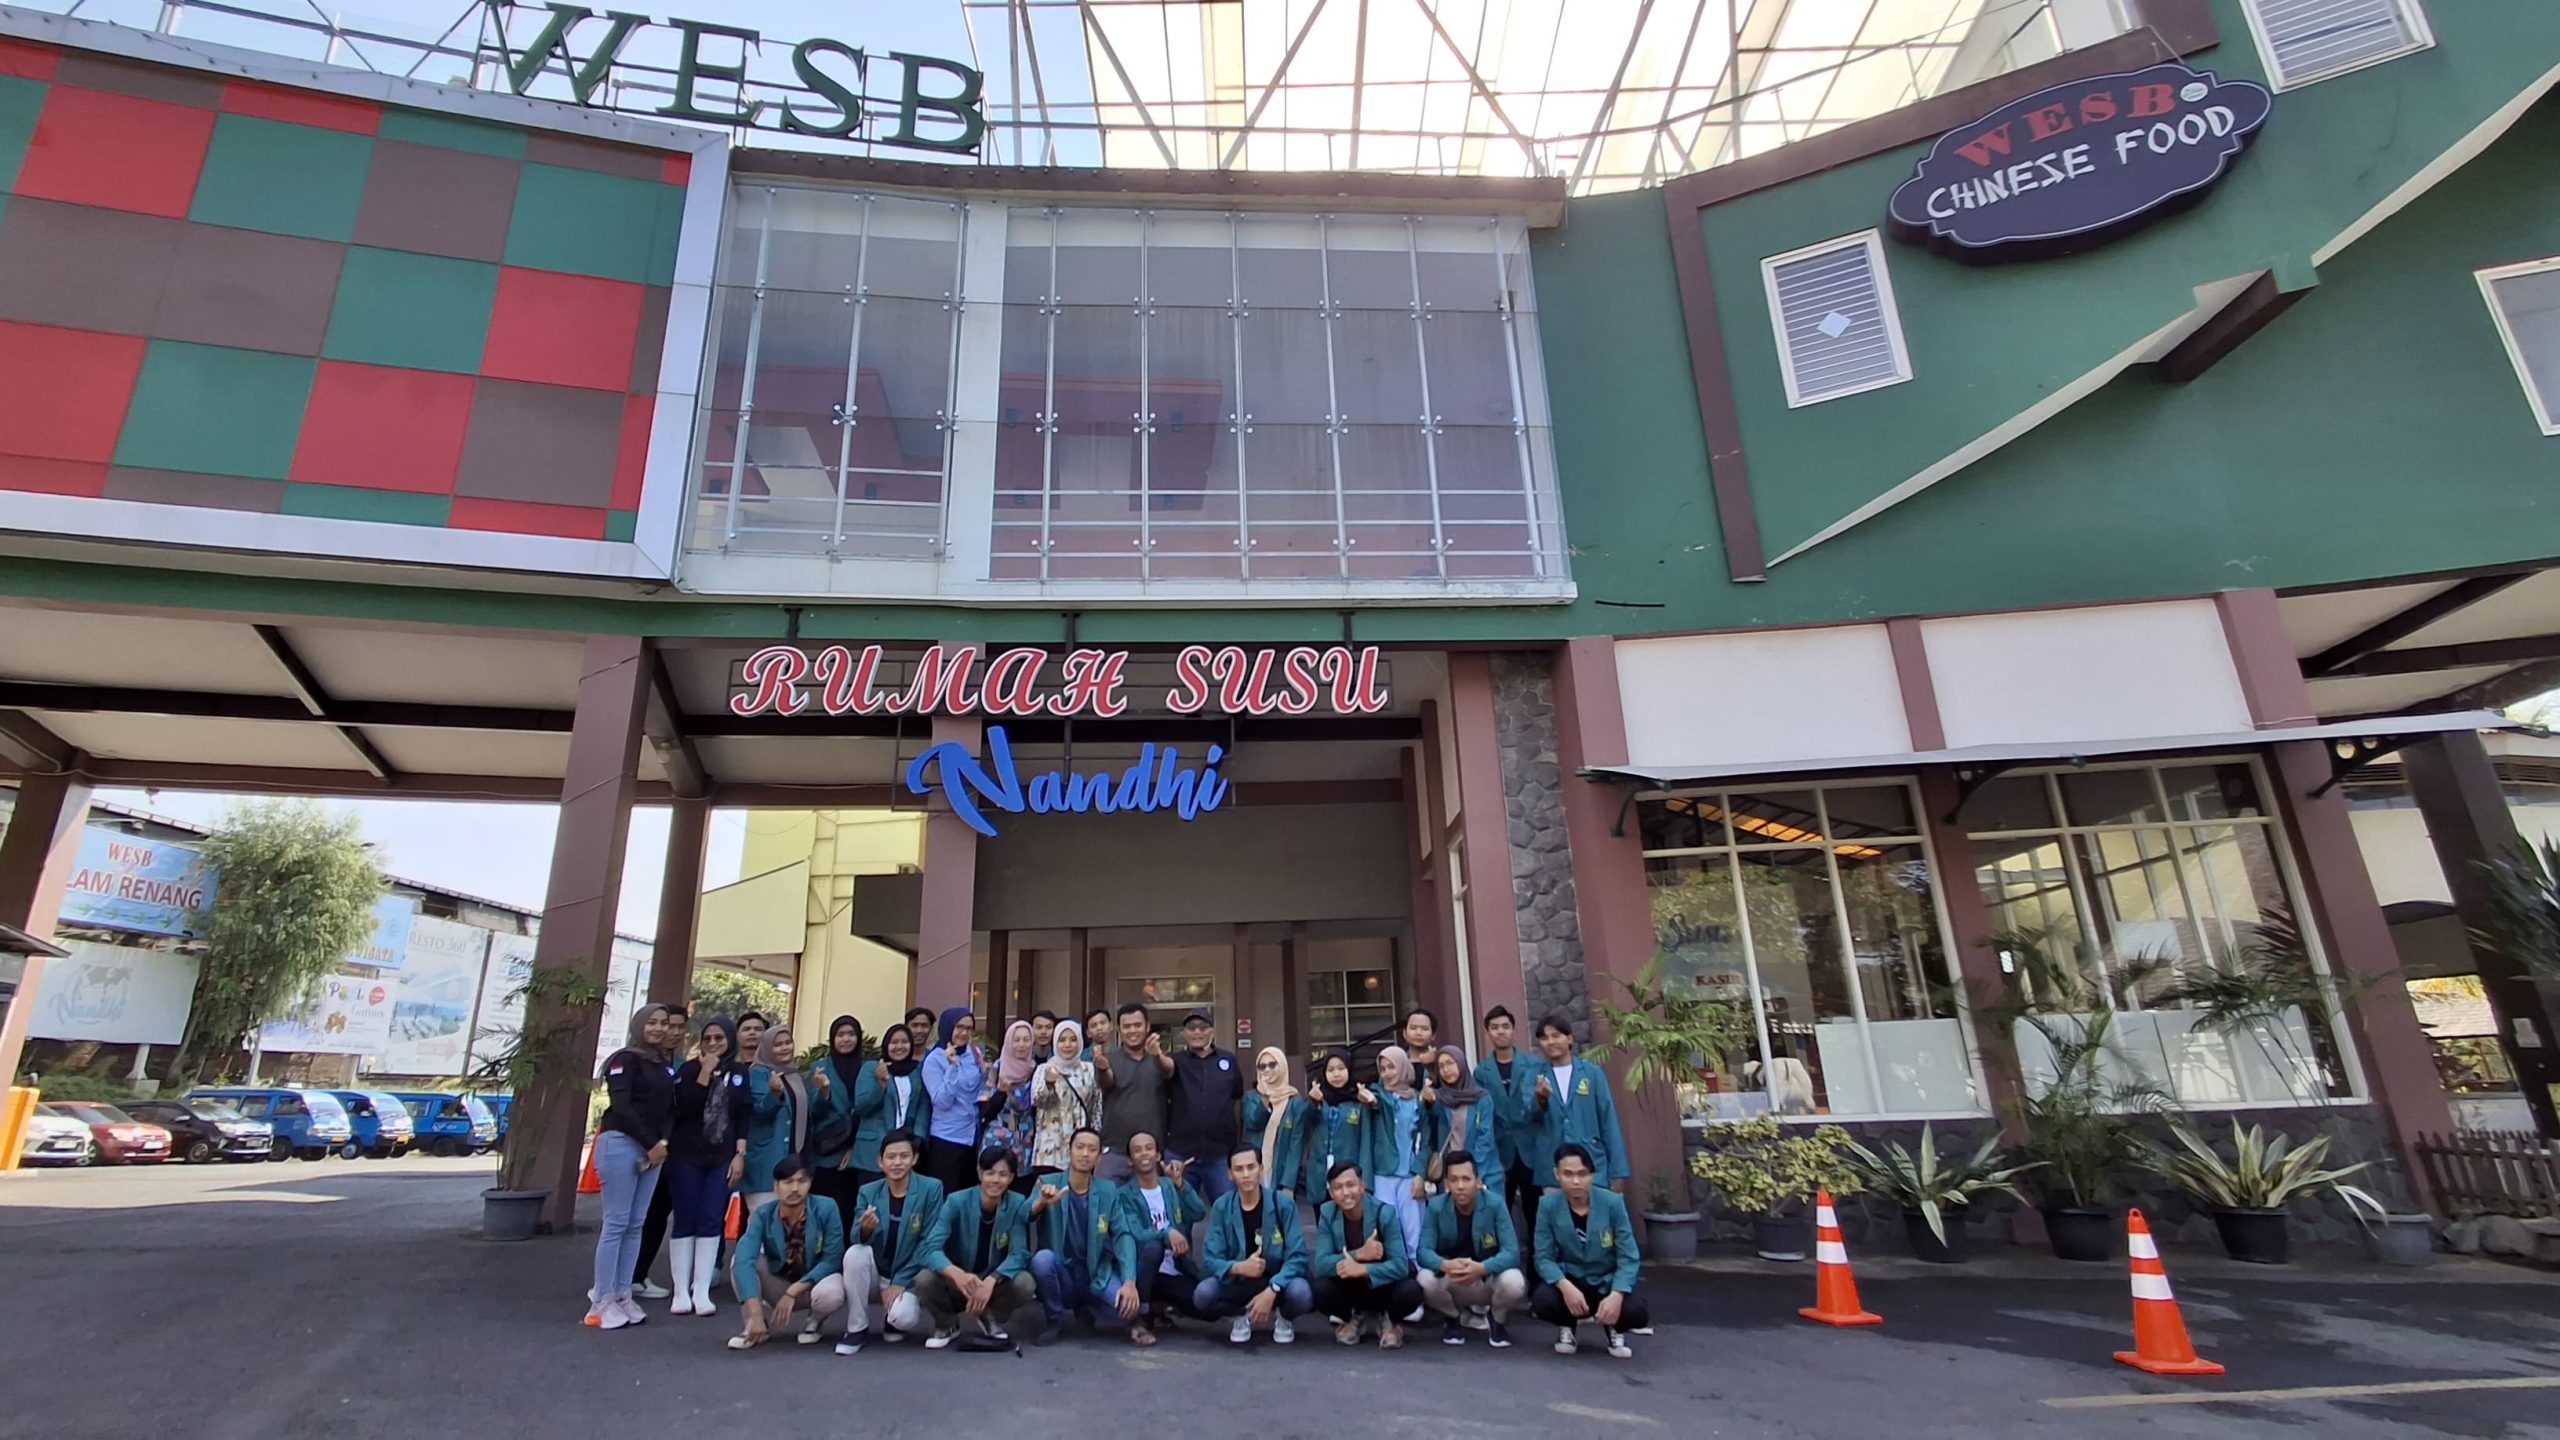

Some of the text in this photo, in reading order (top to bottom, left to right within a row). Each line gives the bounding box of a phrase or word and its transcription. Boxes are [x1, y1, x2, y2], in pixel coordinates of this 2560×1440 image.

[486, 0, 985, 153] WESB
[1926, 105, 2235, 219] CHINESE FOOD
[1954, 83, 2177, 168] WESB
[730, 644, 1389, 718] RUMAH SUSU
[906, 725, 1229, 837] Nandhi
[108, 842, 153, 868] WESB
[118, 875, 203, 911] RENANG
